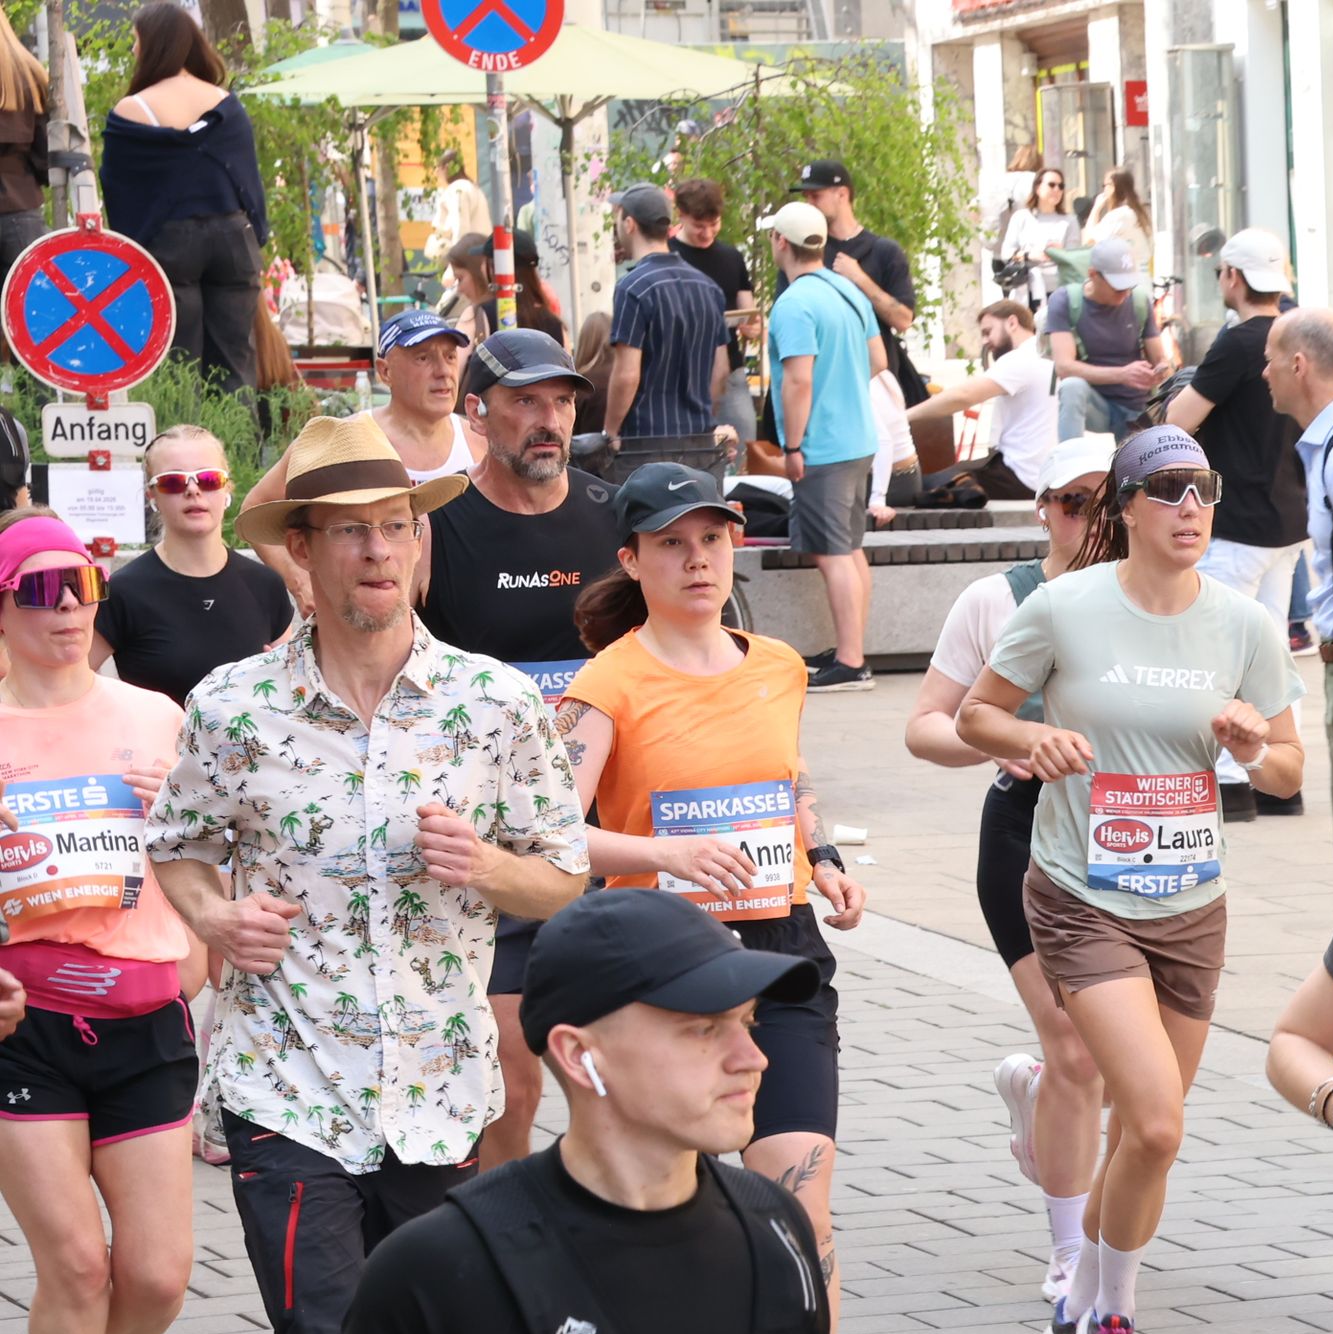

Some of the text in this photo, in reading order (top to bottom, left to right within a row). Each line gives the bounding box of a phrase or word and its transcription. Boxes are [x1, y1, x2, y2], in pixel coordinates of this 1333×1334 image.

[467, 49, 522, 72] ENDE
[51, 416, 147, 447] Anfang
[1133, 665, 1217, 691] TERREX
[1137, 776, 1192, 791] WIENER
[3, 788, 80, 815] ERSTE
[660, 794, 776, 820] SPARKASSE
[1105, 790, 1191, 806] STÄDTISCHE
[56, 829, 140, 855] Martina
[1100, 825, 1214, 850] Hervis Laura
[1, 860, 22, 869] SPORTS
[740, 840, 792, 867] Anna
[95, 862, 113, 870] 5721
[765, 873, 781, 882] 9938
[1117, 874, 1179, 894] ERSTE
[27, 889, 62, 907] WIEN
[65, 885, 119, 899] ENERGIE
[697, 895, 787, 912] WIEN ENERGIE
